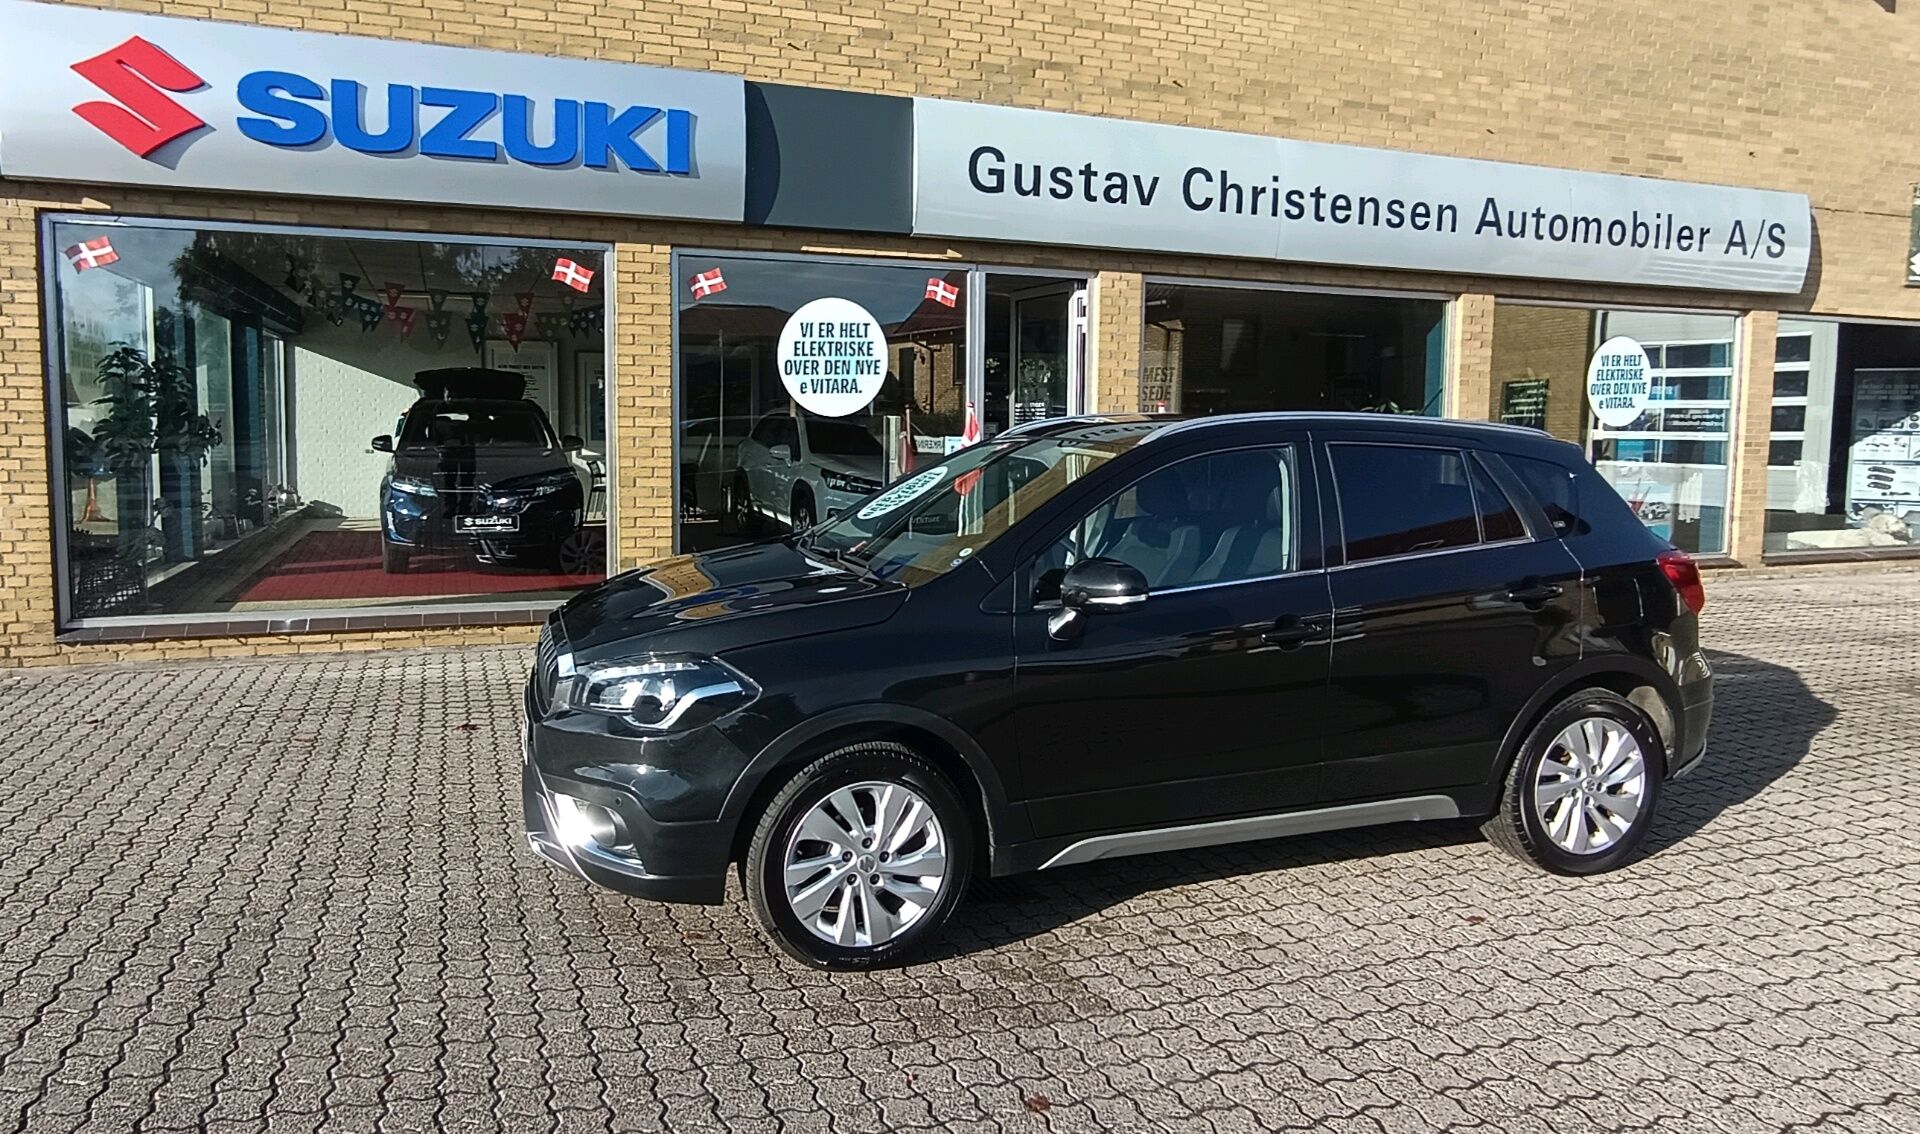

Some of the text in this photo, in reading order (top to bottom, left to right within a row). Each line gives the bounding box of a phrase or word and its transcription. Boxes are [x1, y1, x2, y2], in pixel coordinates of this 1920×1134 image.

[236, 70, 693, 174] SUZUKI
[968, 145, 1788, 259] Gustav Christensen Automobiler A/S
[799, 322, 871, 338] VI ER HELT
[793, 341, 874, 357] ELEKTRISKE
[784, 359, 881, 376] OVER DEN NYE
[1601, 354, 1643, 367] VI ER HELT
[1143, 366, 1176, 383] MEST
[1596, 368, 1644, 381] ELEKTRISKE
[800, 378, 863, 394] e VITARA.
[1142, 385, 1171, 401] SEDE
[1590, 383, 1612, 396] OVER
[1613, 382, 1630, 395] DEN
[1631, 382, 1647, 395] NYE
[1599, 397, 1636, 409] e VITARA.
[474, 517, 512, 525] SUZUKI
